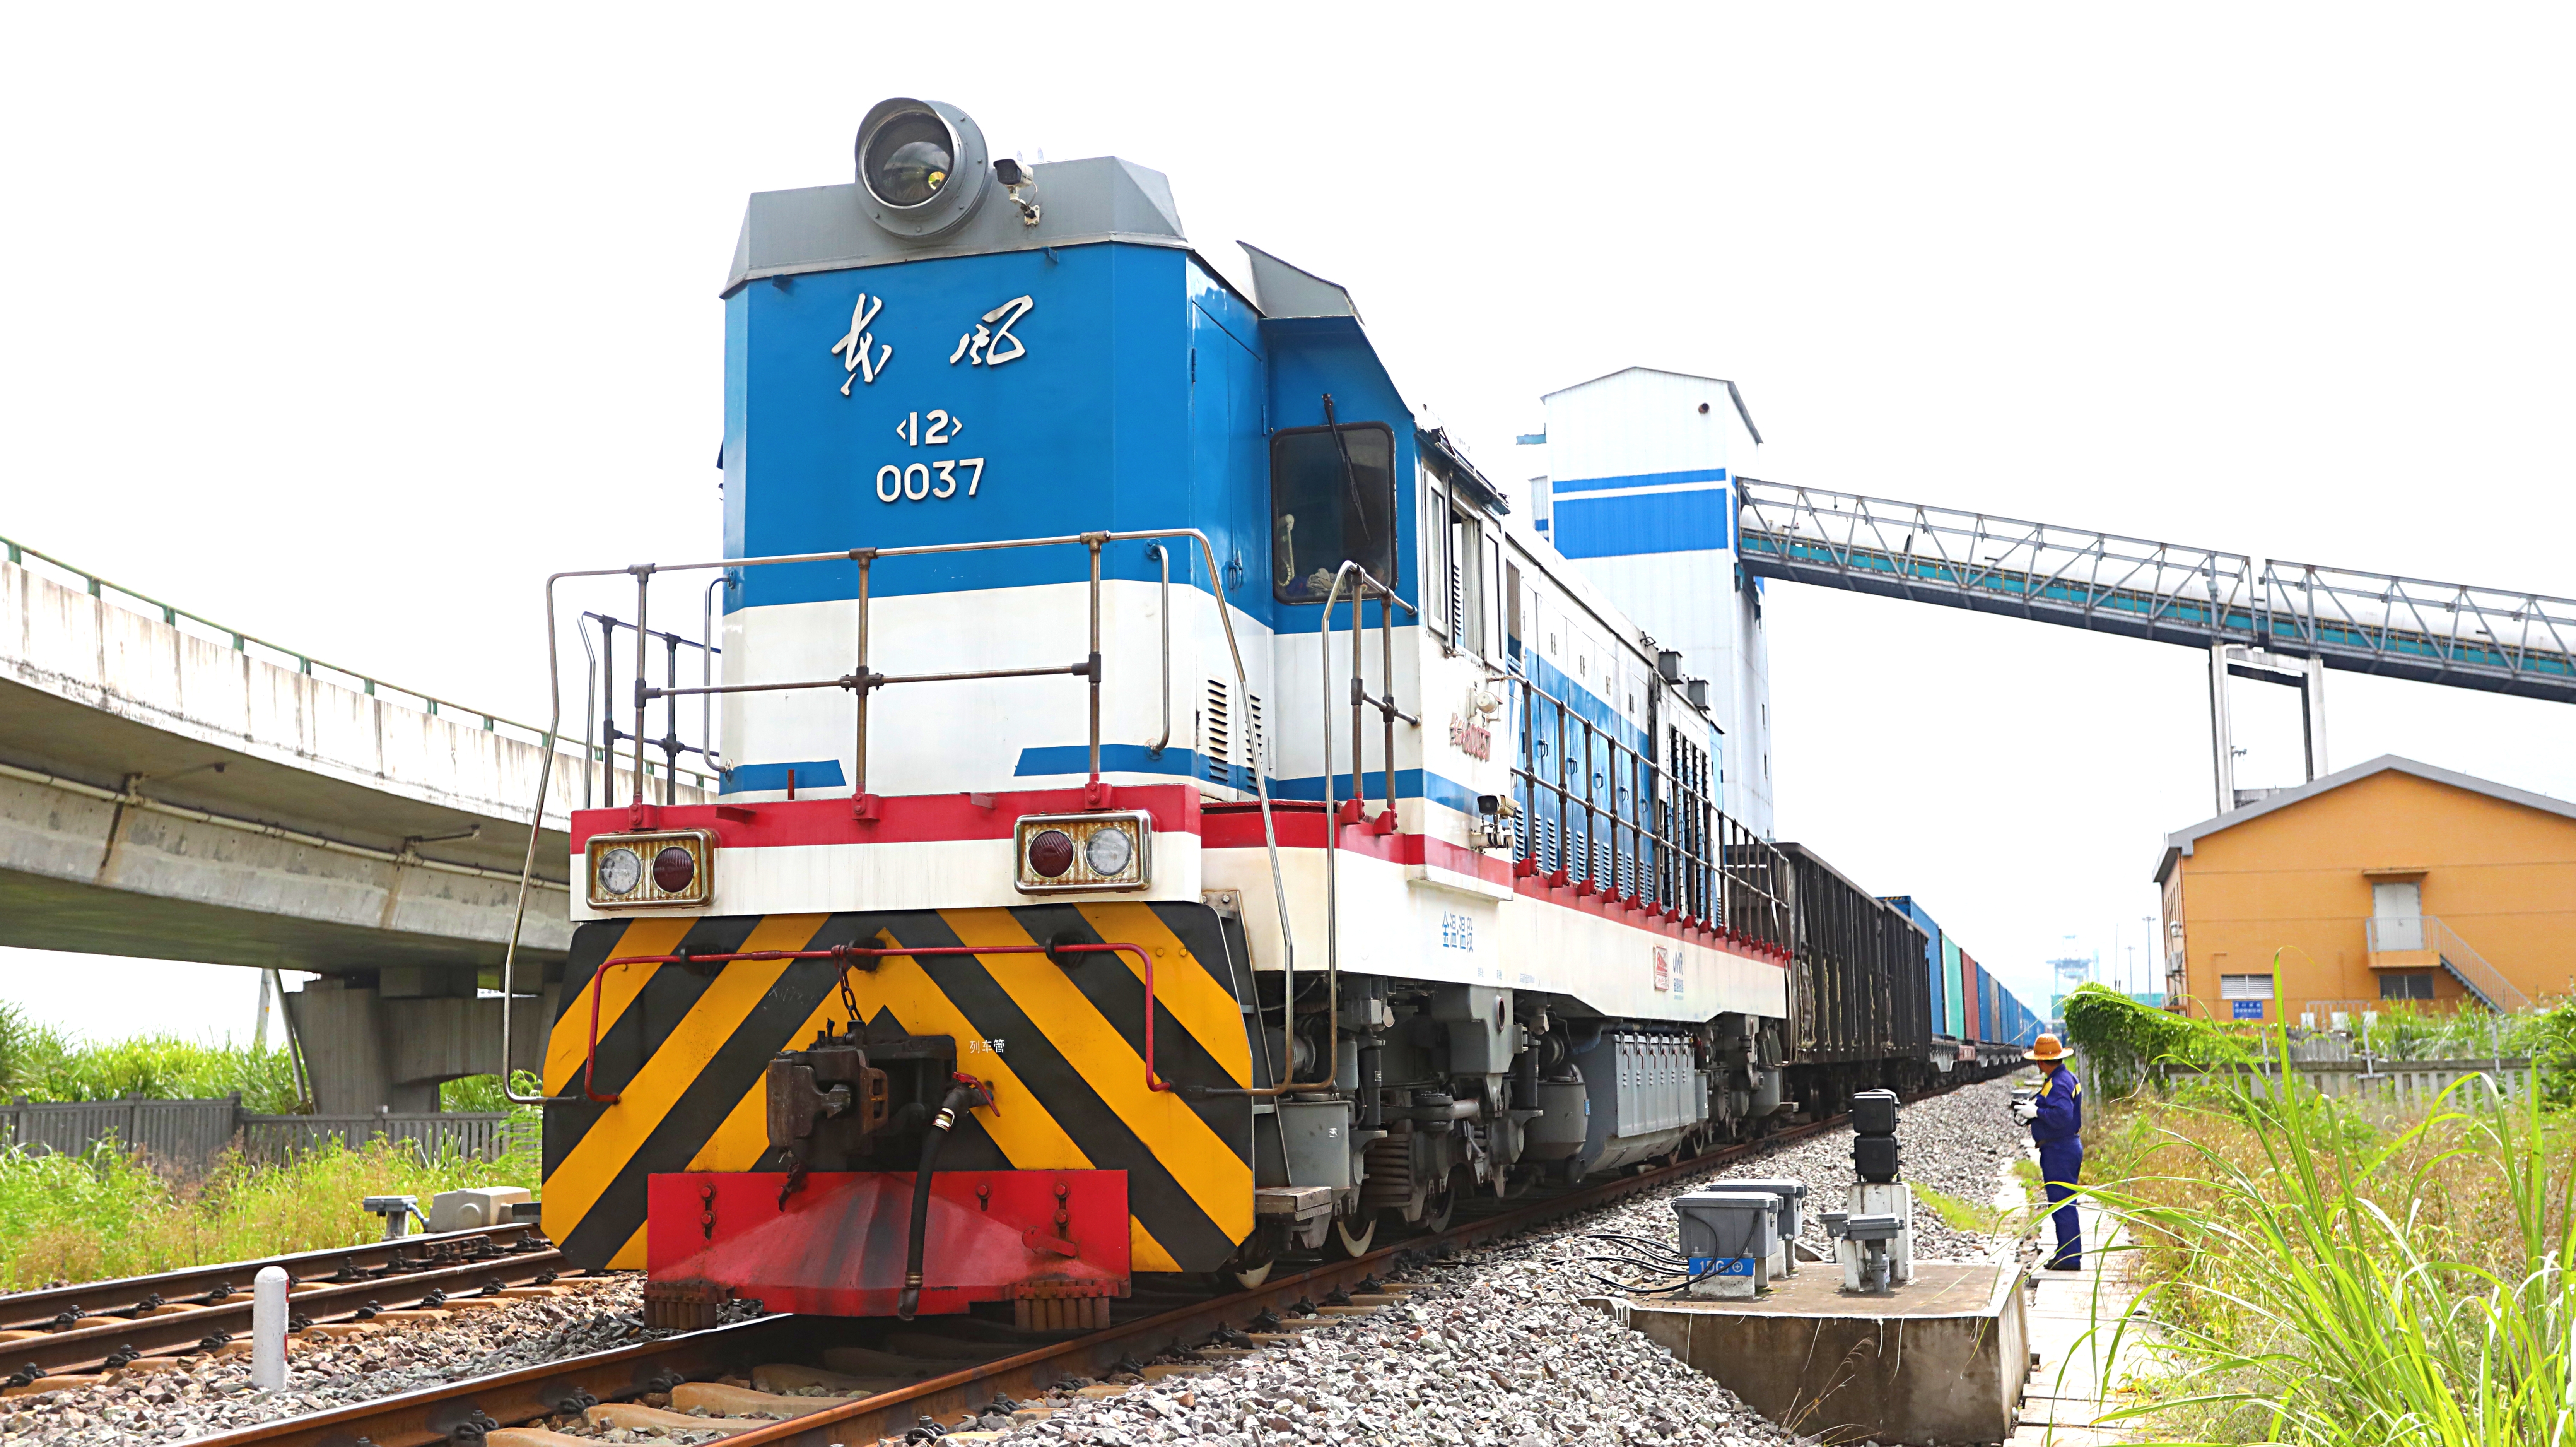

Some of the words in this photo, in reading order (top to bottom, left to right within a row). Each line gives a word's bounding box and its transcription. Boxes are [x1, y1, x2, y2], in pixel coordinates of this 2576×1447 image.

[876, 457, 985, 502] 0037
[969, 1039, 1004, 1054] 列车管
